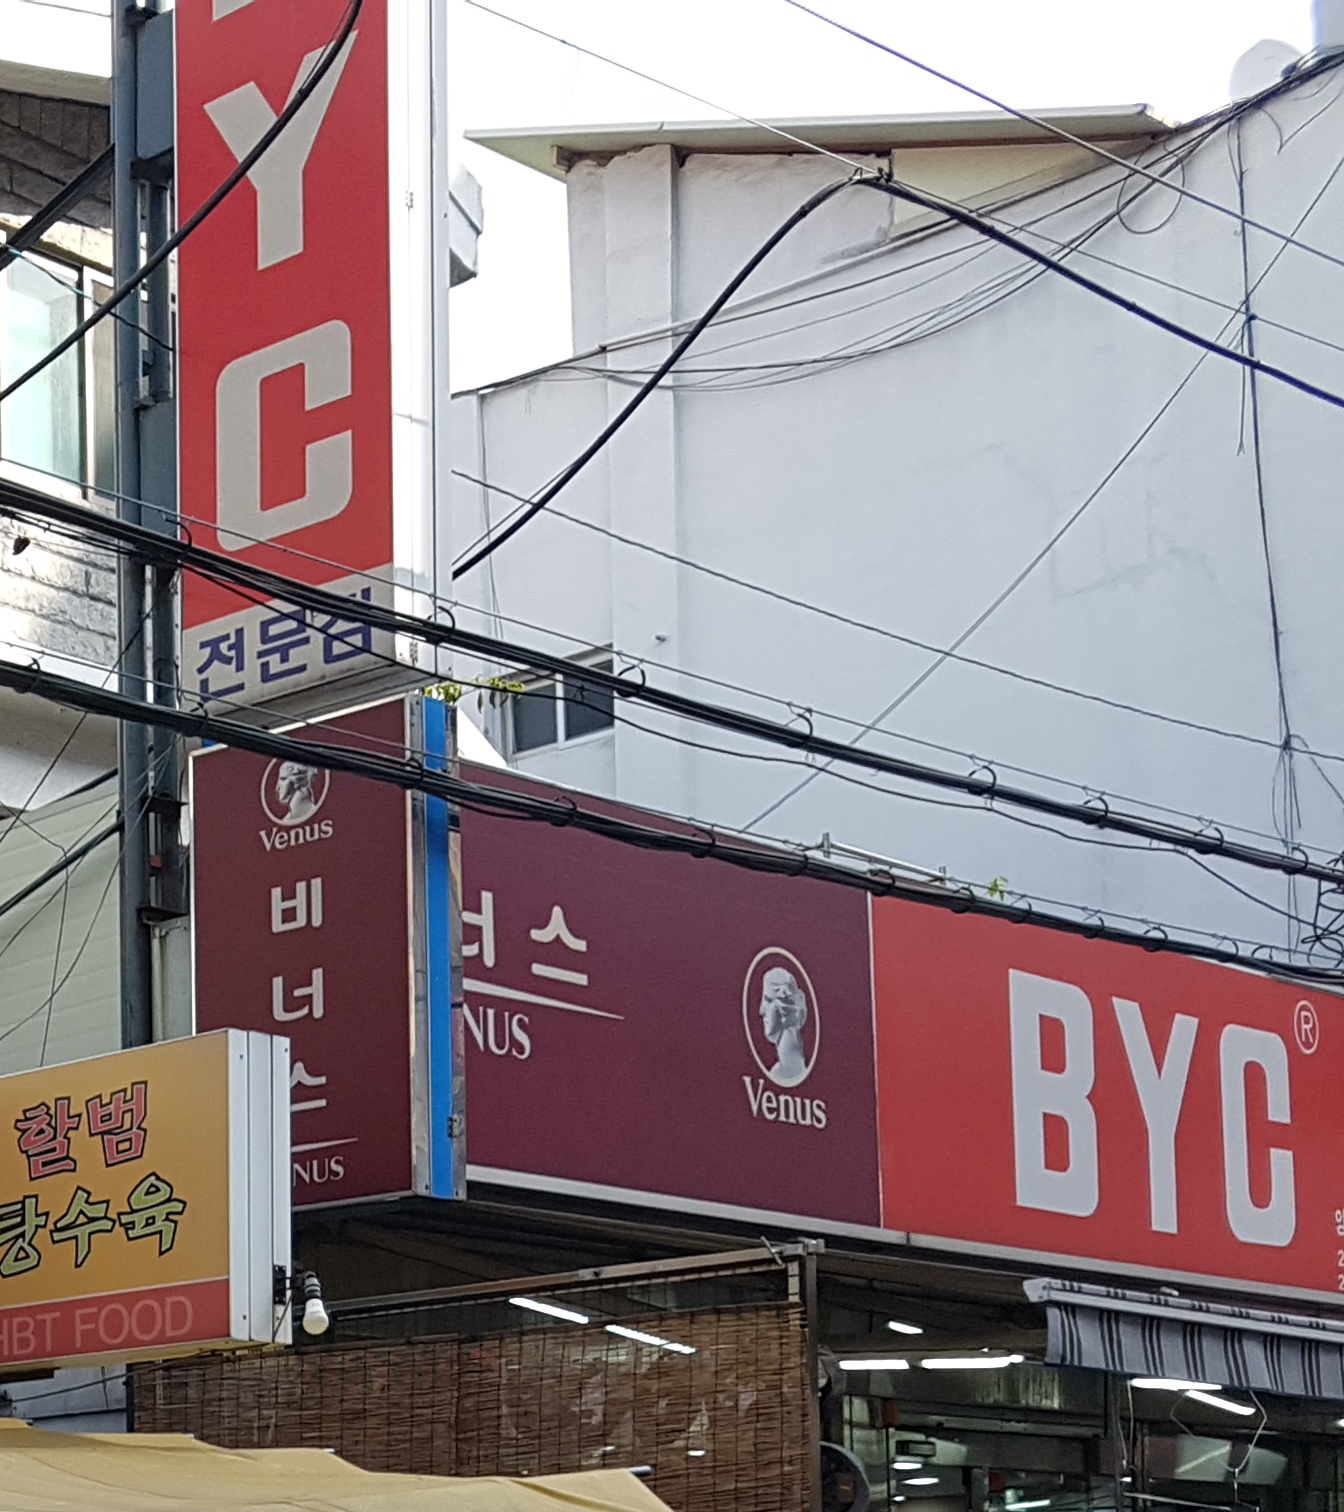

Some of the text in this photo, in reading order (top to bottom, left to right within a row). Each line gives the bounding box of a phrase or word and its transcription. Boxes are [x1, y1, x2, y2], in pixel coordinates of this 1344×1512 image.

[202, 0, 359, 551] YC
[196, 588, 372, 700] 전문점
[259, 817, 333, 852] Venus
[463, 1003, 532, 1061] NUS
[15, 1080, 149, 1180] 할범
[743, 1076, 827, 1128] Venus
[1008, 968, 1296, 1247] BYC
[292, 1155, 345, 1186] NUS
[75, 1296, 193, 1349] FOOD
